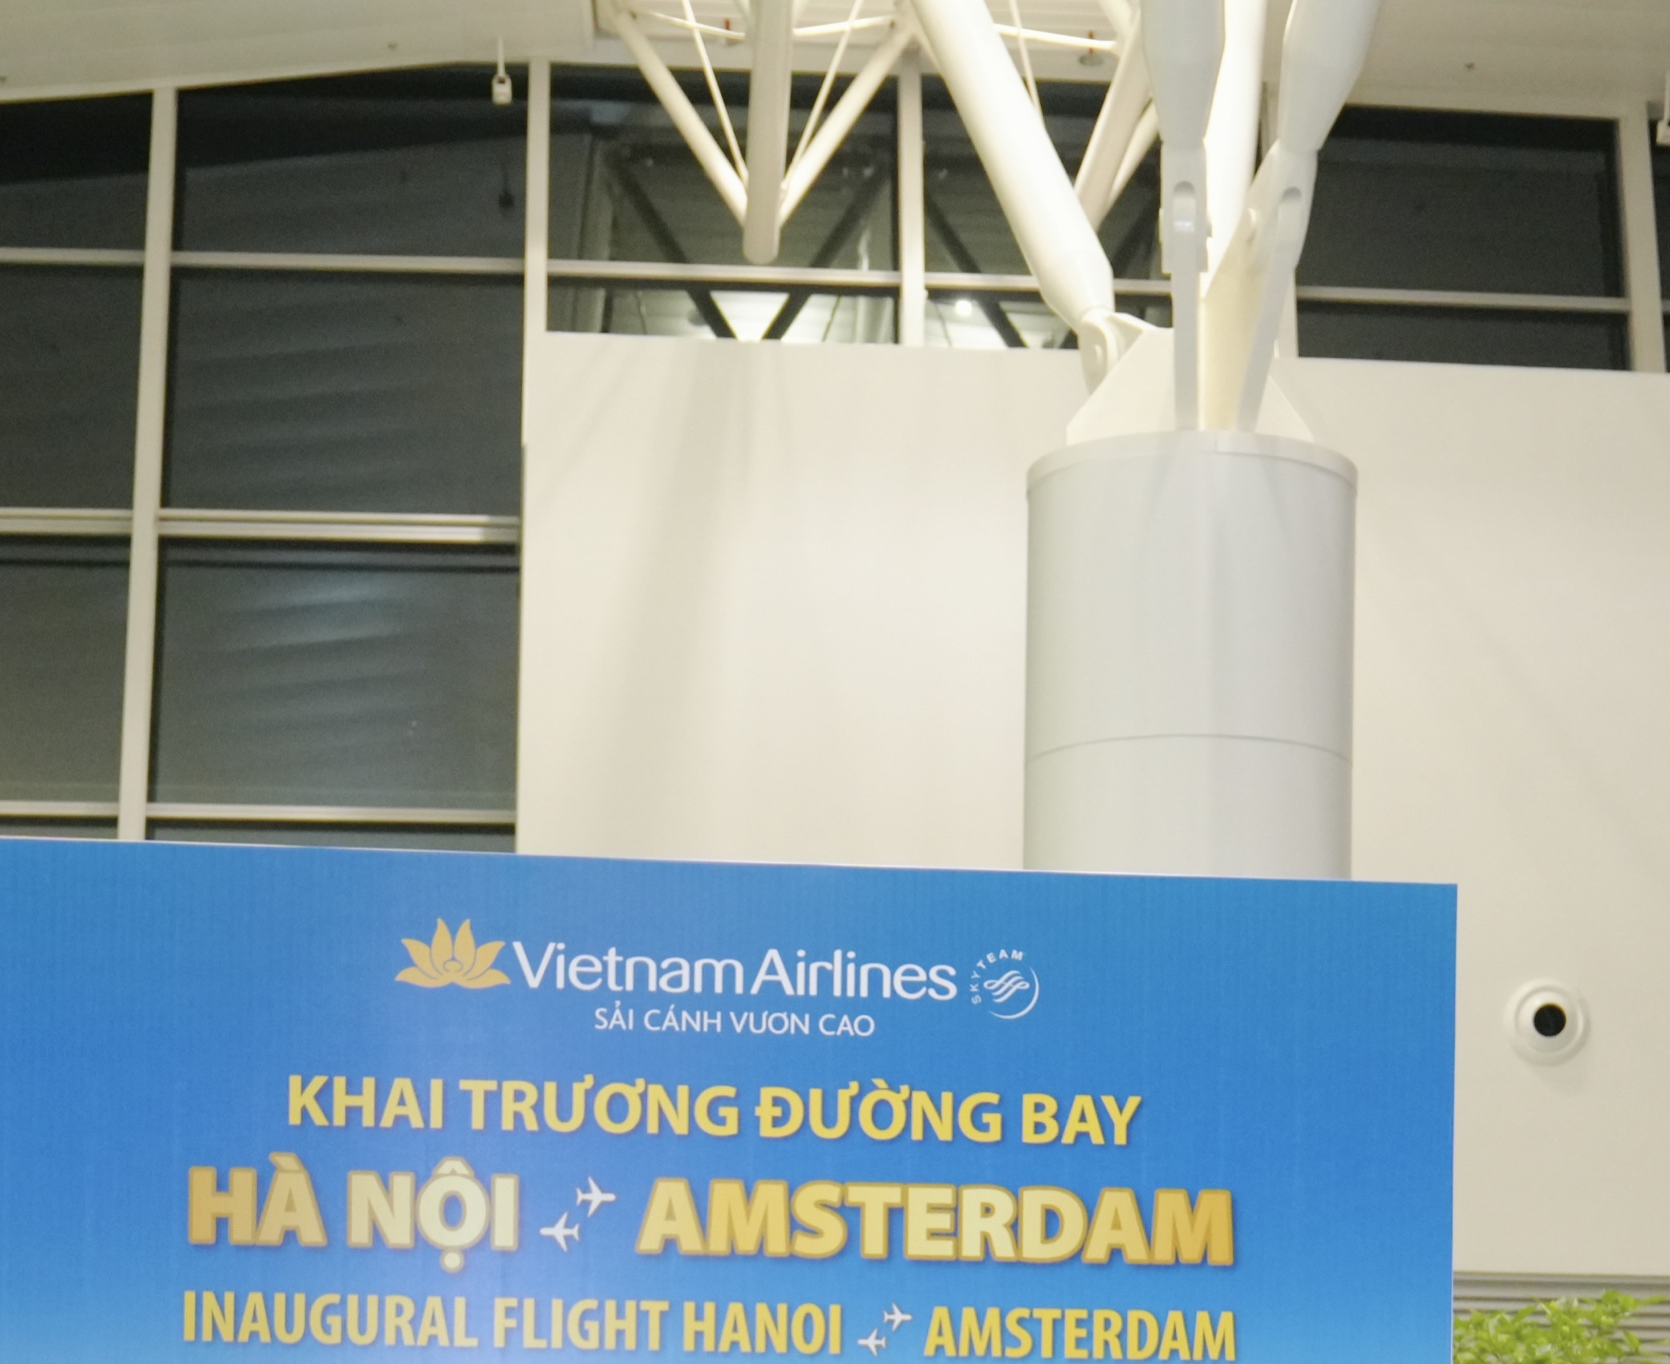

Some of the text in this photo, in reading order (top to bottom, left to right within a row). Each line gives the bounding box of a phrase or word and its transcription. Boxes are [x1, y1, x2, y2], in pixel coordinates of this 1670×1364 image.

[512, 941, 958, 1001] Vietnam Airlines
[969, 948, 1024, 1005] SKYTEAM
[594, 1000, 876, 1036] SẢI CÁNH VƯƠN CAO
[288, 1073, 1142, 1146] KHAI TRƯƠNG ĐƯỜNG BAY
[188, 1151, 1236, 1273] HÀ NỘI AMSTERDAM
[183, 1290, 1237, 1362] INAUGURAL FLIGHT HANOI AMSTERDAM
